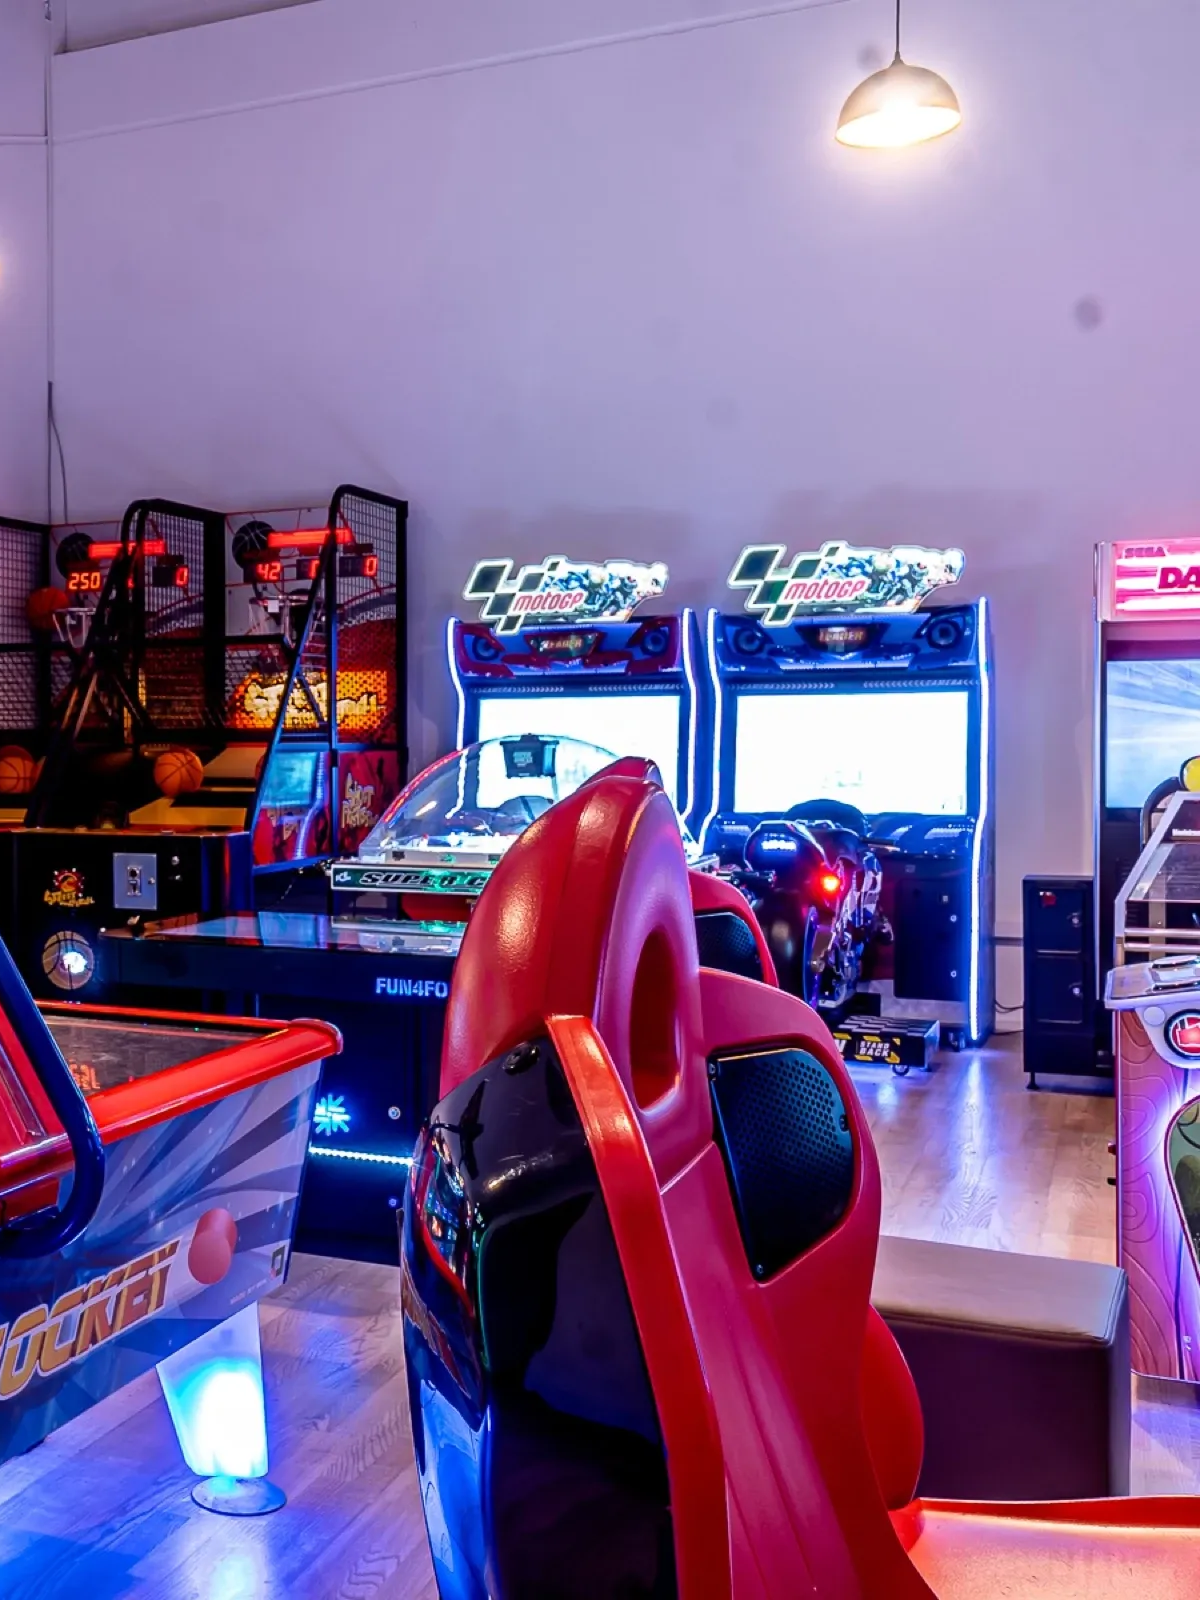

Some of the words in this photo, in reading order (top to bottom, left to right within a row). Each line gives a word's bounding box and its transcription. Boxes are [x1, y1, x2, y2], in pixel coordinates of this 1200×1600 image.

[256, 561, 281, 580] 42
[68, 571, 101, 590] 250
[375, 977, 449, 998] FUN4FO
[860, 1041, 890, 1049] STAND
[860, 1047, 890, 1057] BACK
